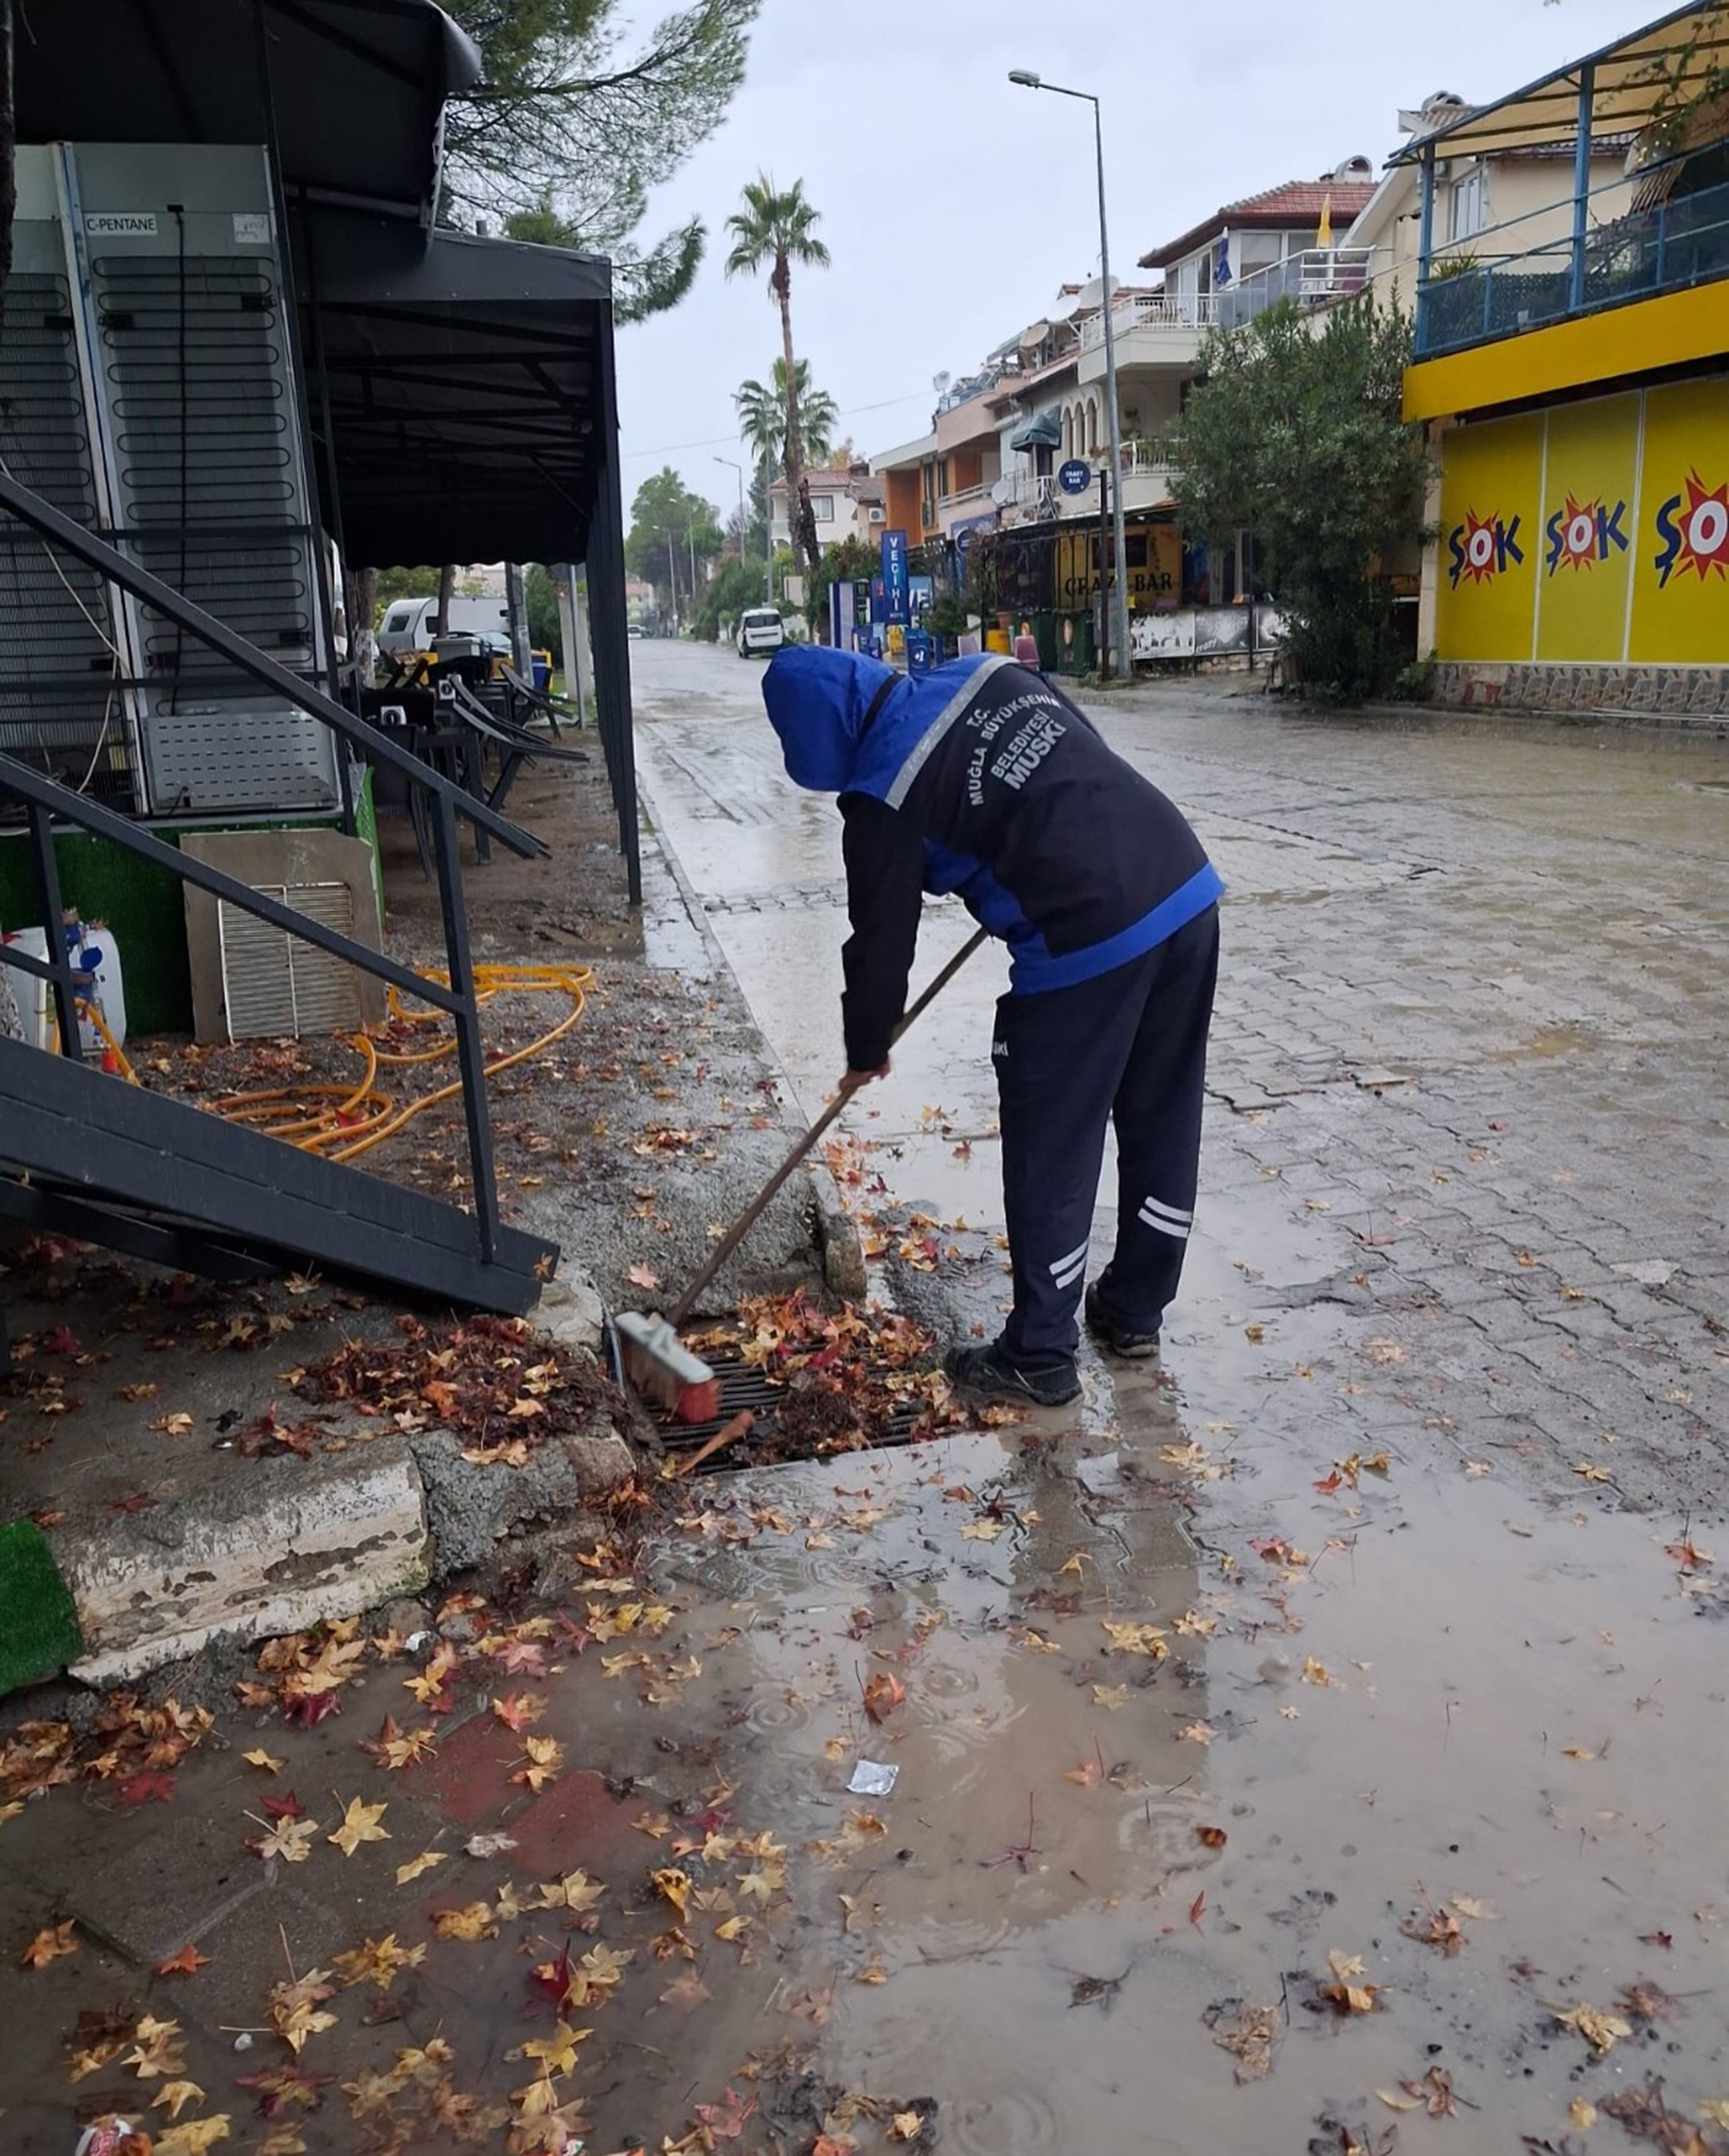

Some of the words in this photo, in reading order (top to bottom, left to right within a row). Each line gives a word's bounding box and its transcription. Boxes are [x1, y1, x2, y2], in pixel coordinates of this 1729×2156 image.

[87, 218, 156, 231] C-PENTANE
[1449, 514, 1524, 591] ŞOK
[1546, 499, 1629, 578] ŞOK
[1655, 493, 1729, 589] ŞO
[1065, 574, 1128, 596] CRAZ
[1135, 571, 1173, 591] BAR
[966, 709, 991, 727] T.C.
[991, 708, 1050, 778] BELEDİYESİ
[968, 748, 988, 806] MUĞLA
